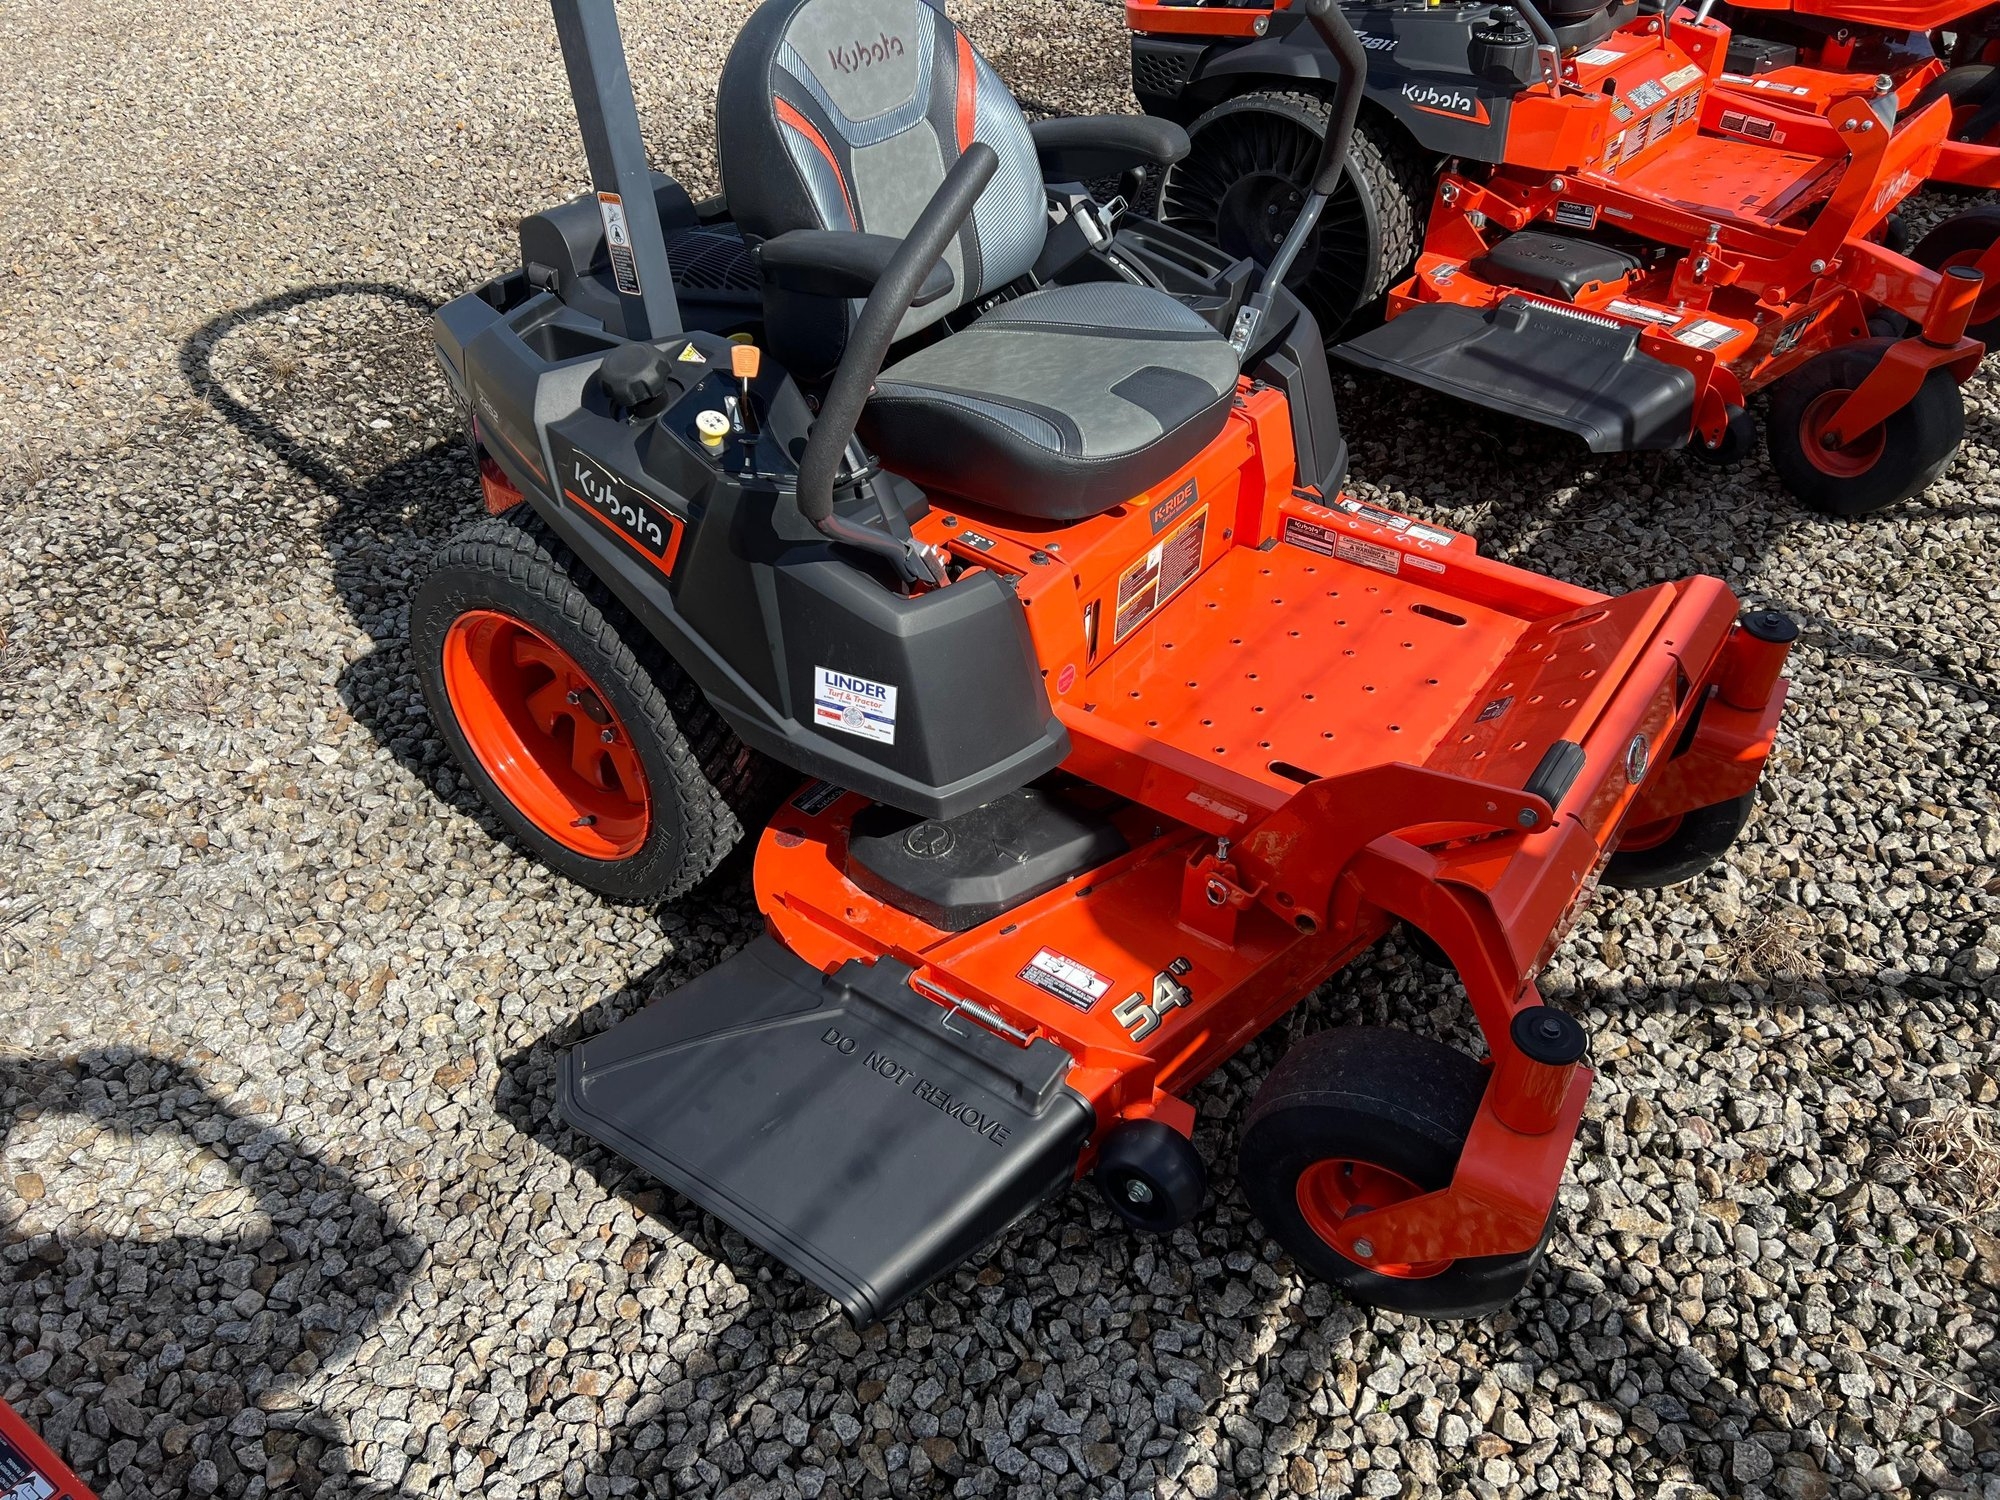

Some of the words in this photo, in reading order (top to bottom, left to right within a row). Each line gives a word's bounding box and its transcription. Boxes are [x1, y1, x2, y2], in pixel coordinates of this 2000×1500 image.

[828, 32, 904, 73] Kubota
[1402, 83, 1471, 111] Kubota
[575, 461, 662, 546] Kubota
[1294, 521, 1319, 534] Kubota
[1355, 546, 1381, 558] WARNING
[825, 671, 887, 701] LINDER
[828, 688, 844, 700] Turf
[845, 693, 853, 702] &
[854, 694, 883, 709] Tractor
[1064, 958, 1096, 978] DANGER
[1112, 958, 1192, 1042] 54"
[821, 1026, 858, 1055] DO
[862, 1050, 916, 1087] NOT
[912, 1078, 1012, 1147] REMOVE
